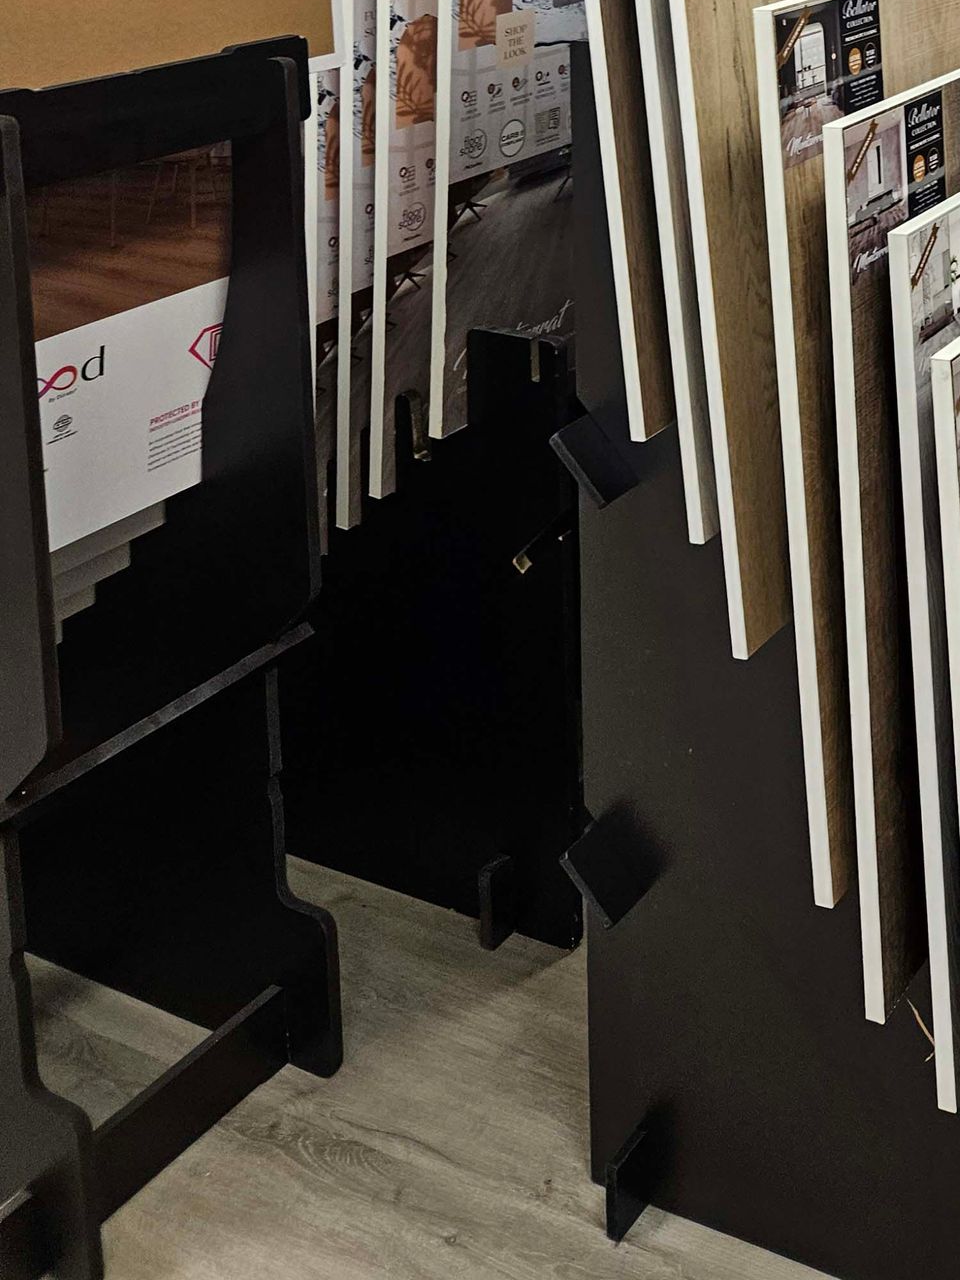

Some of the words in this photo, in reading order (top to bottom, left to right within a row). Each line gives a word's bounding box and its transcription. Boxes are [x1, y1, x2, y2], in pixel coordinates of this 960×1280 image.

[505, 24, 527, 37] SHOP
[508, 35, 524, 47] THE
[504, 48, 527, 60] LOOK
[150, 403, 190, 426] PROTECTED
